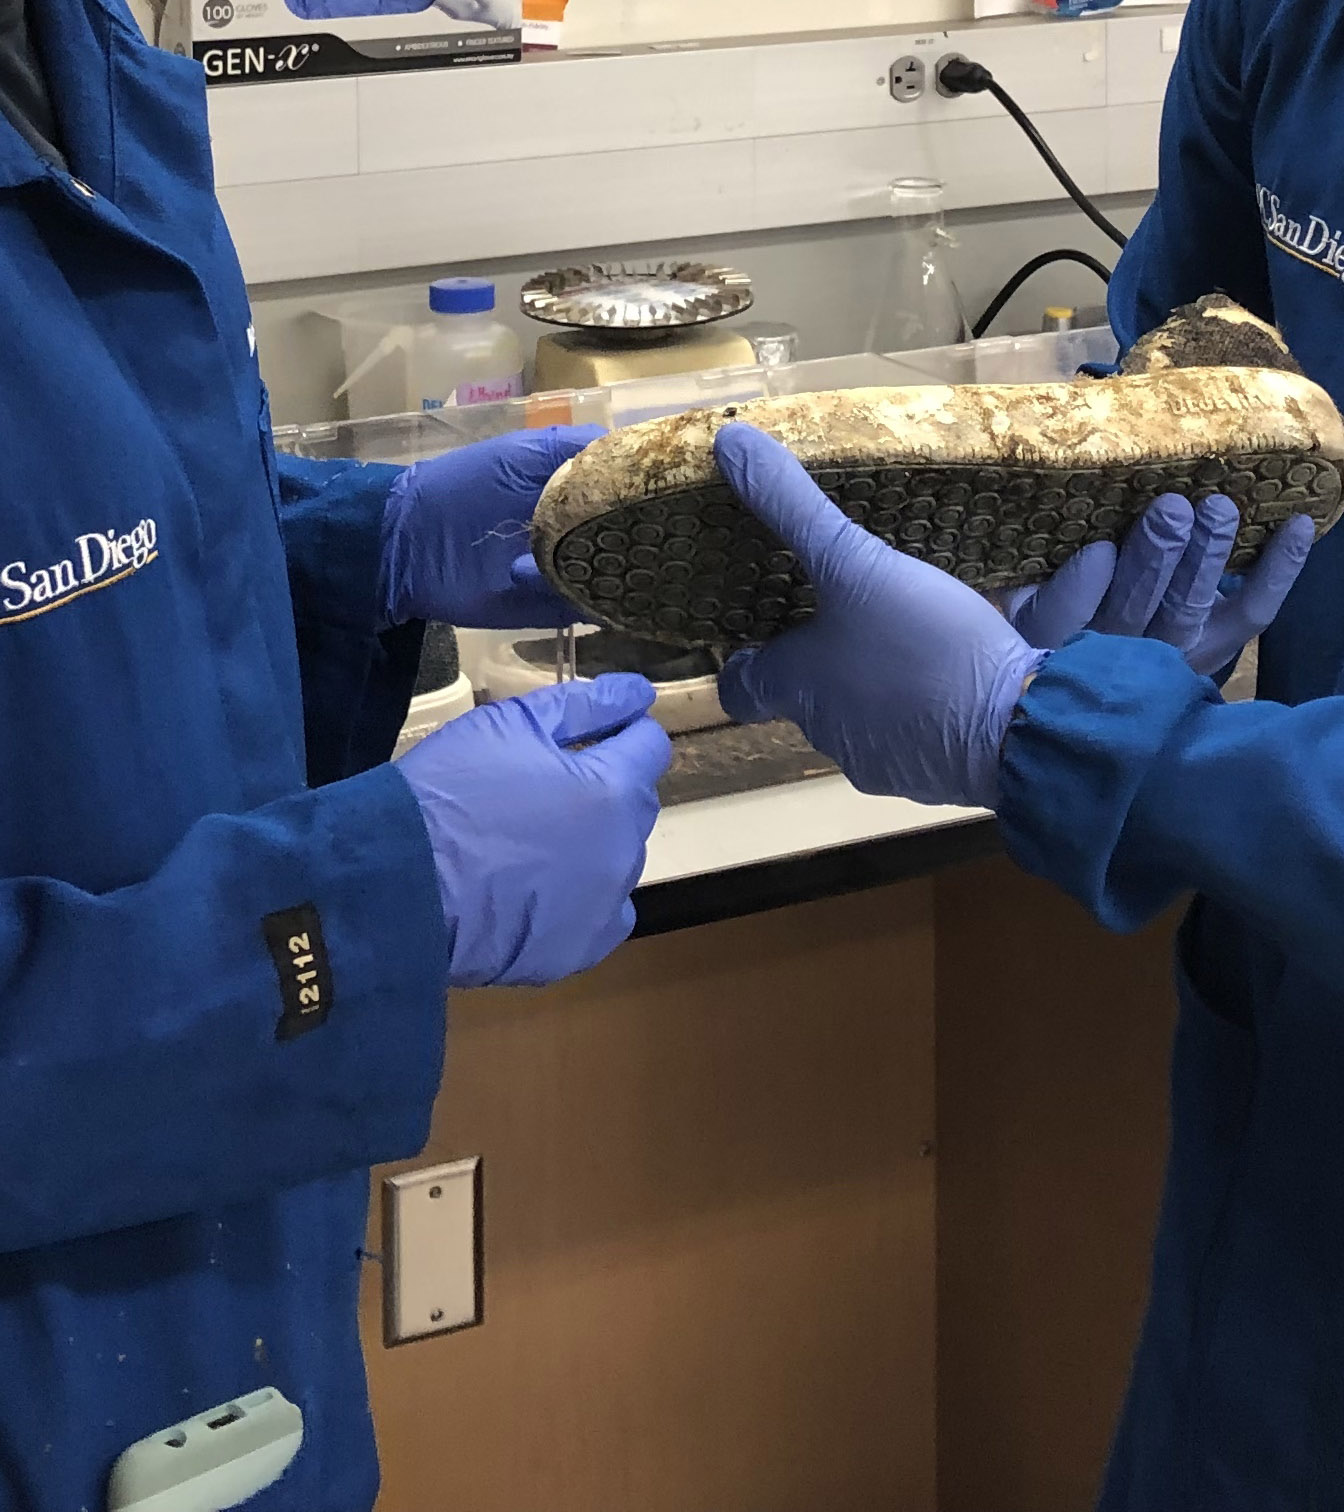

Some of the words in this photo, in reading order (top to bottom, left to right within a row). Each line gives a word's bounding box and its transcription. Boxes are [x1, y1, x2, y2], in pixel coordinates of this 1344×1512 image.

[205, 5, 233, 21] 100
[0, 561, 80, 611] San
[75, 518, 157, 570] Diego
